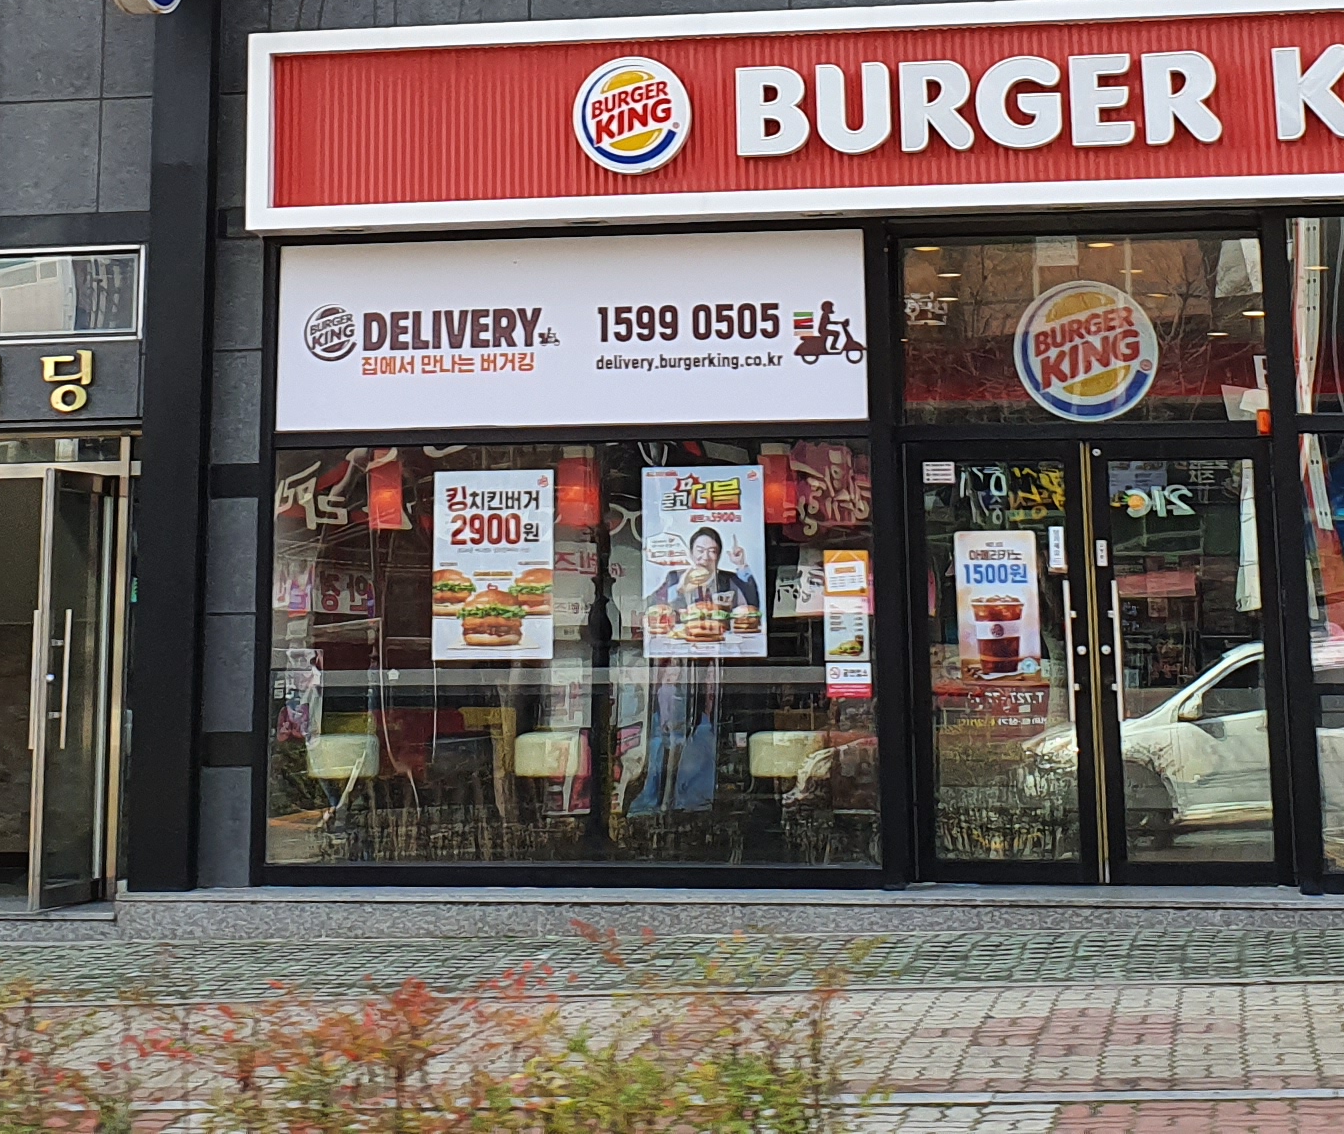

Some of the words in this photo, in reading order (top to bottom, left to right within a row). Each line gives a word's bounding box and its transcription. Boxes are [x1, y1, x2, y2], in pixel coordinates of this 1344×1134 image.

[591, 80, 668, 120] BURGER
[734, 50, 1223, 157] BURGER
[595, 98, 672, 146] KING
[309, 312, 354, 336] BURGER
[311, 324, 356, 350] KING
[362, 307, 542, 352] DELIVERY
[597, 304, 679, 343] 1599
[692, 302, 780, 340] 0505
[1033, 306, 1136, 358] BURGER
[361, 355, 416, 376] 집에서
[421, 353, 475, 374] 만나는
[480, 352, 535, 372] 버거킹
[596, 352, 784, 371] delivery.burgerking.co.kr
[1039, 329, 1142, 391] KING
[446, 486, 540, 513] 킹치킨버거
[450, 513, 540, 545] 2900원
[964, 563, 1028, 584] 1500원
